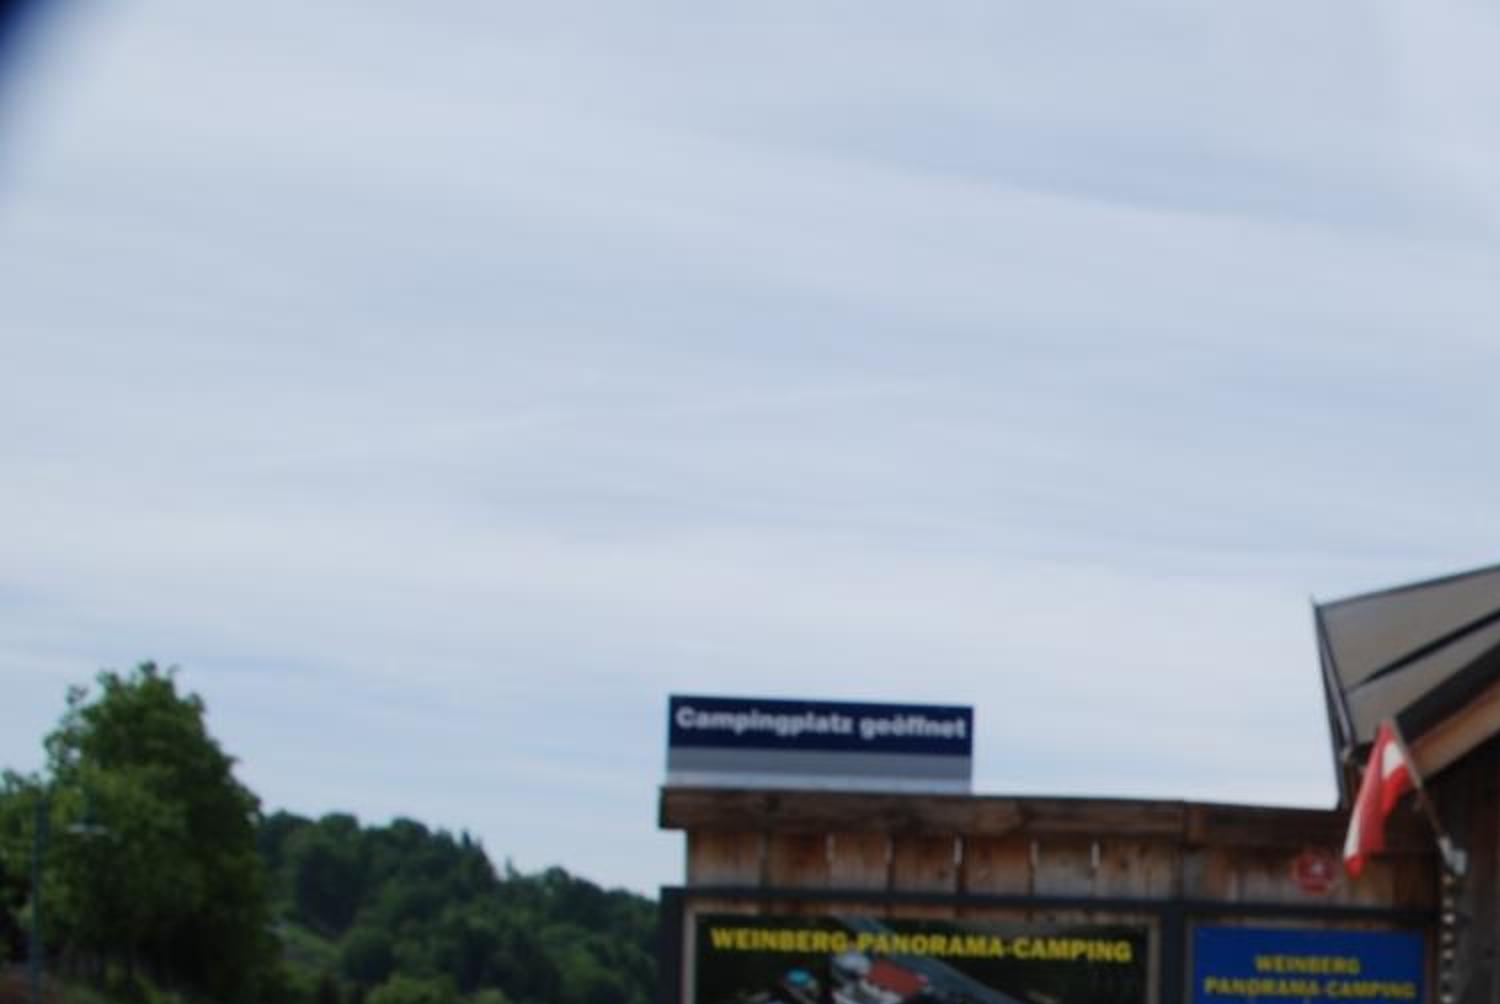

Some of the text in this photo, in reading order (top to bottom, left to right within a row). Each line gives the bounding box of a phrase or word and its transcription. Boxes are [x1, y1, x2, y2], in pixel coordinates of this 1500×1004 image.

[676, 706, 966, 739] Campingplatz geöffnet
[711, 928, 1132, 962] WEINBERG-PANORAMA-CAMPING
